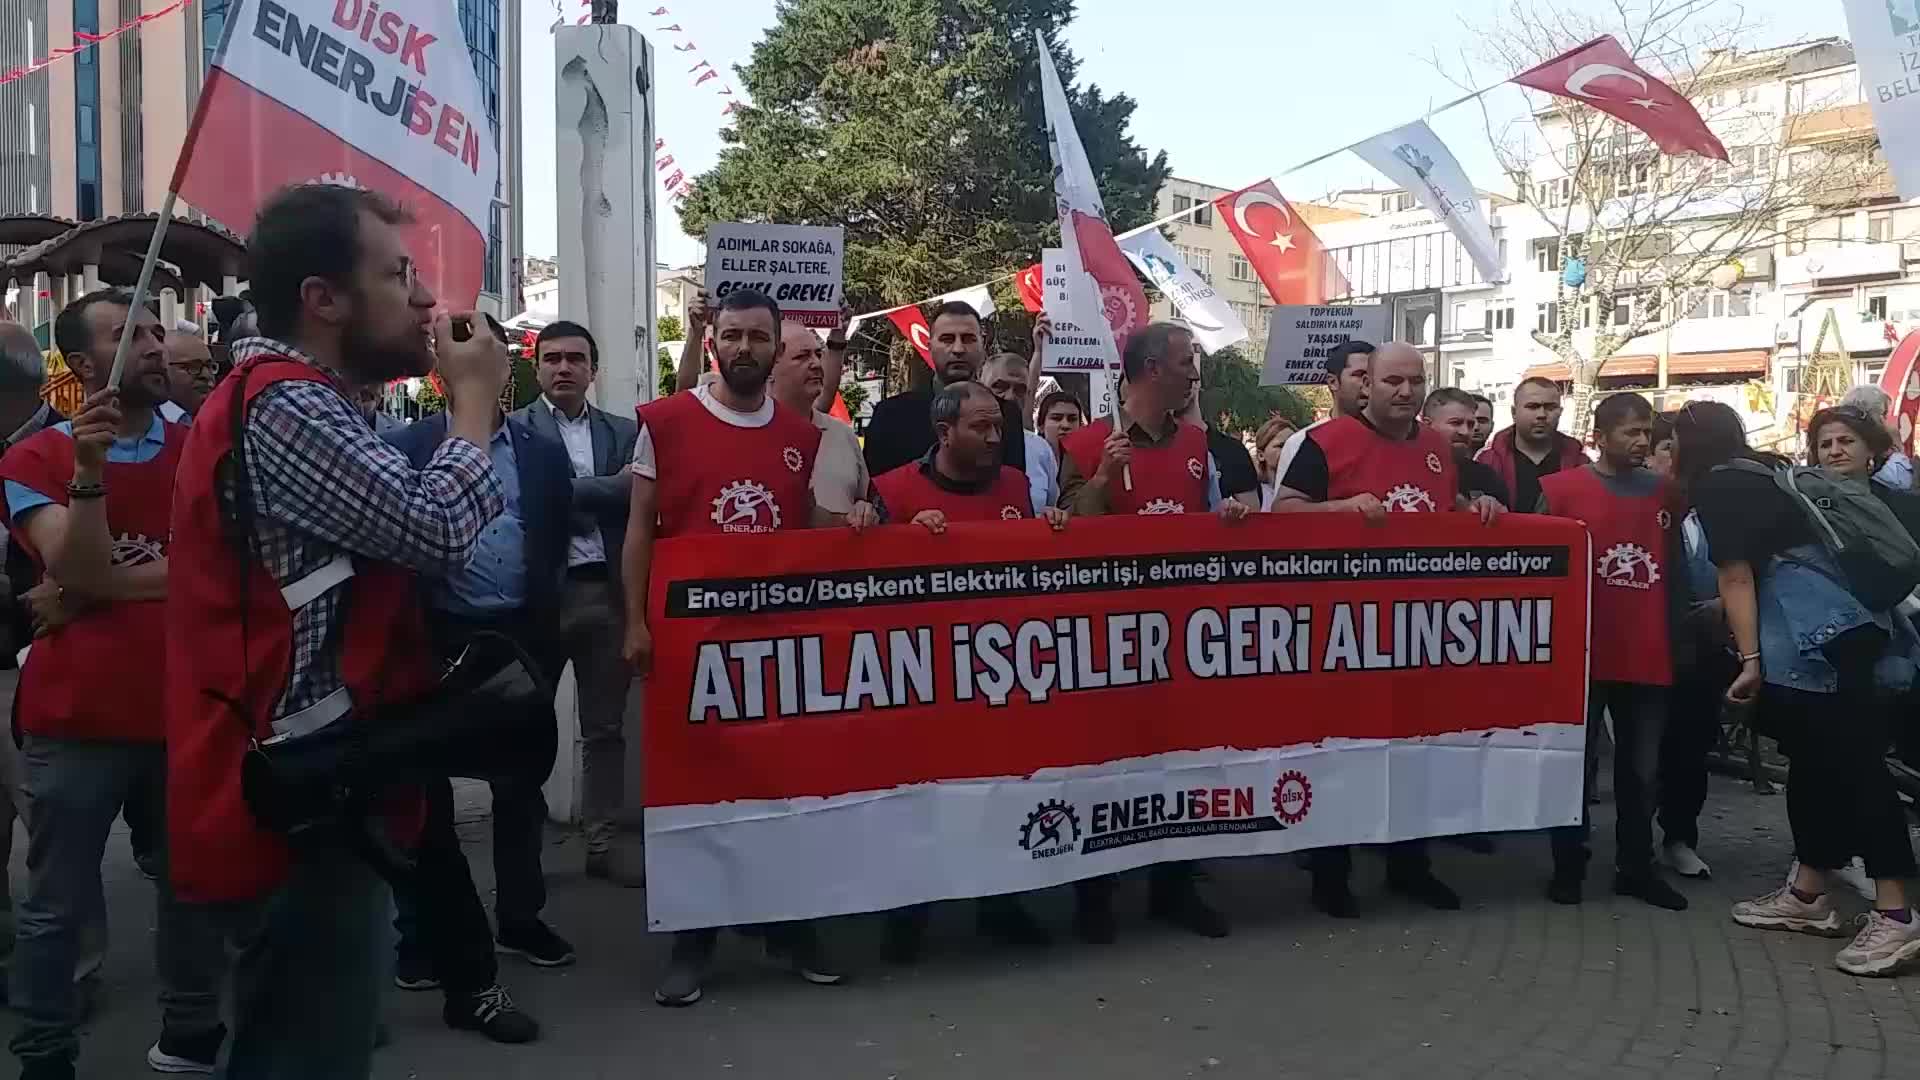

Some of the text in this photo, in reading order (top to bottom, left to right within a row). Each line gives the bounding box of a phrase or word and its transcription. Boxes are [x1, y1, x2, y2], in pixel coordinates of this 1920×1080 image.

[1899, 52, 1920, 73] İZ
[1876, 72, 1920, 104] BEL
[717, 237, 836, 256] ADIMLAR SOKAĞA,
[721, 258, 831, 276] ELLER ŞALTERE,
[776, 283, 835, 303] GREVE!
[1339, 319, 1363, 331] KARŞI
[1307, 333, 1351, 346] YAŞASIN
[1285, 359, 1314, 370] EMEK
[687, 551, 1552, 612] EnerjiSa/Başkent Elektrik işçileri işi, ekmeği ve hakları için mücadele ediyor
[687, 597, 1553, 723] ATILAN İŞÇİLER GERİ ALINSIN!
